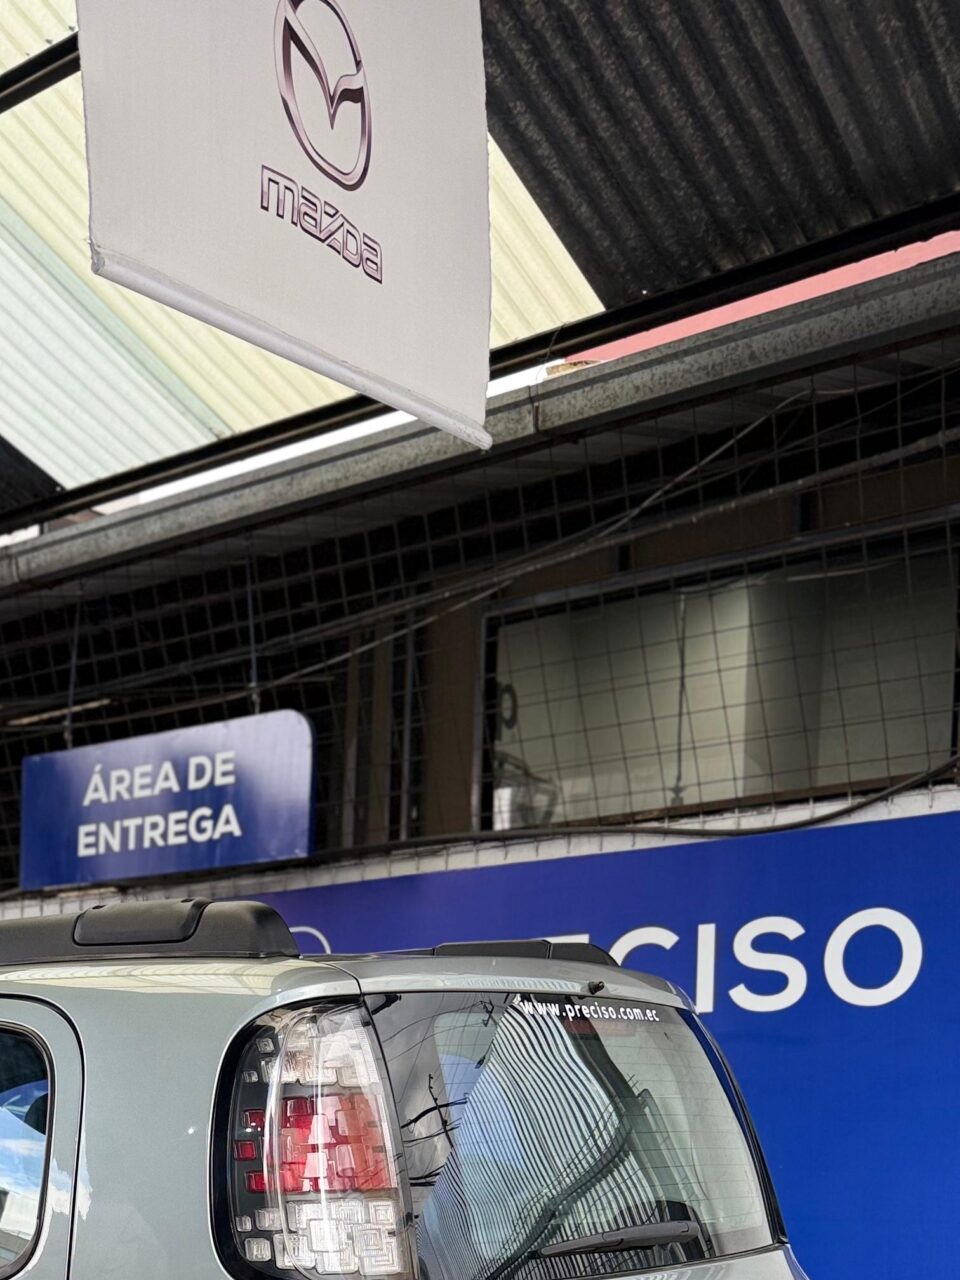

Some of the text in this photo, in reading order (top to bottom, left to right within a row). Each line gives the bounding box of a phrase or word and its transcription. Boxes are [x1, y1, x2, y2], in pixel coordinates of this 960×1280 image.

[83, 750, 236, 807] ÁREA DE
[77, 804, 242, 858] ENTREGA
[520, 1000, 660, 1021] www.preciso.com.ec
